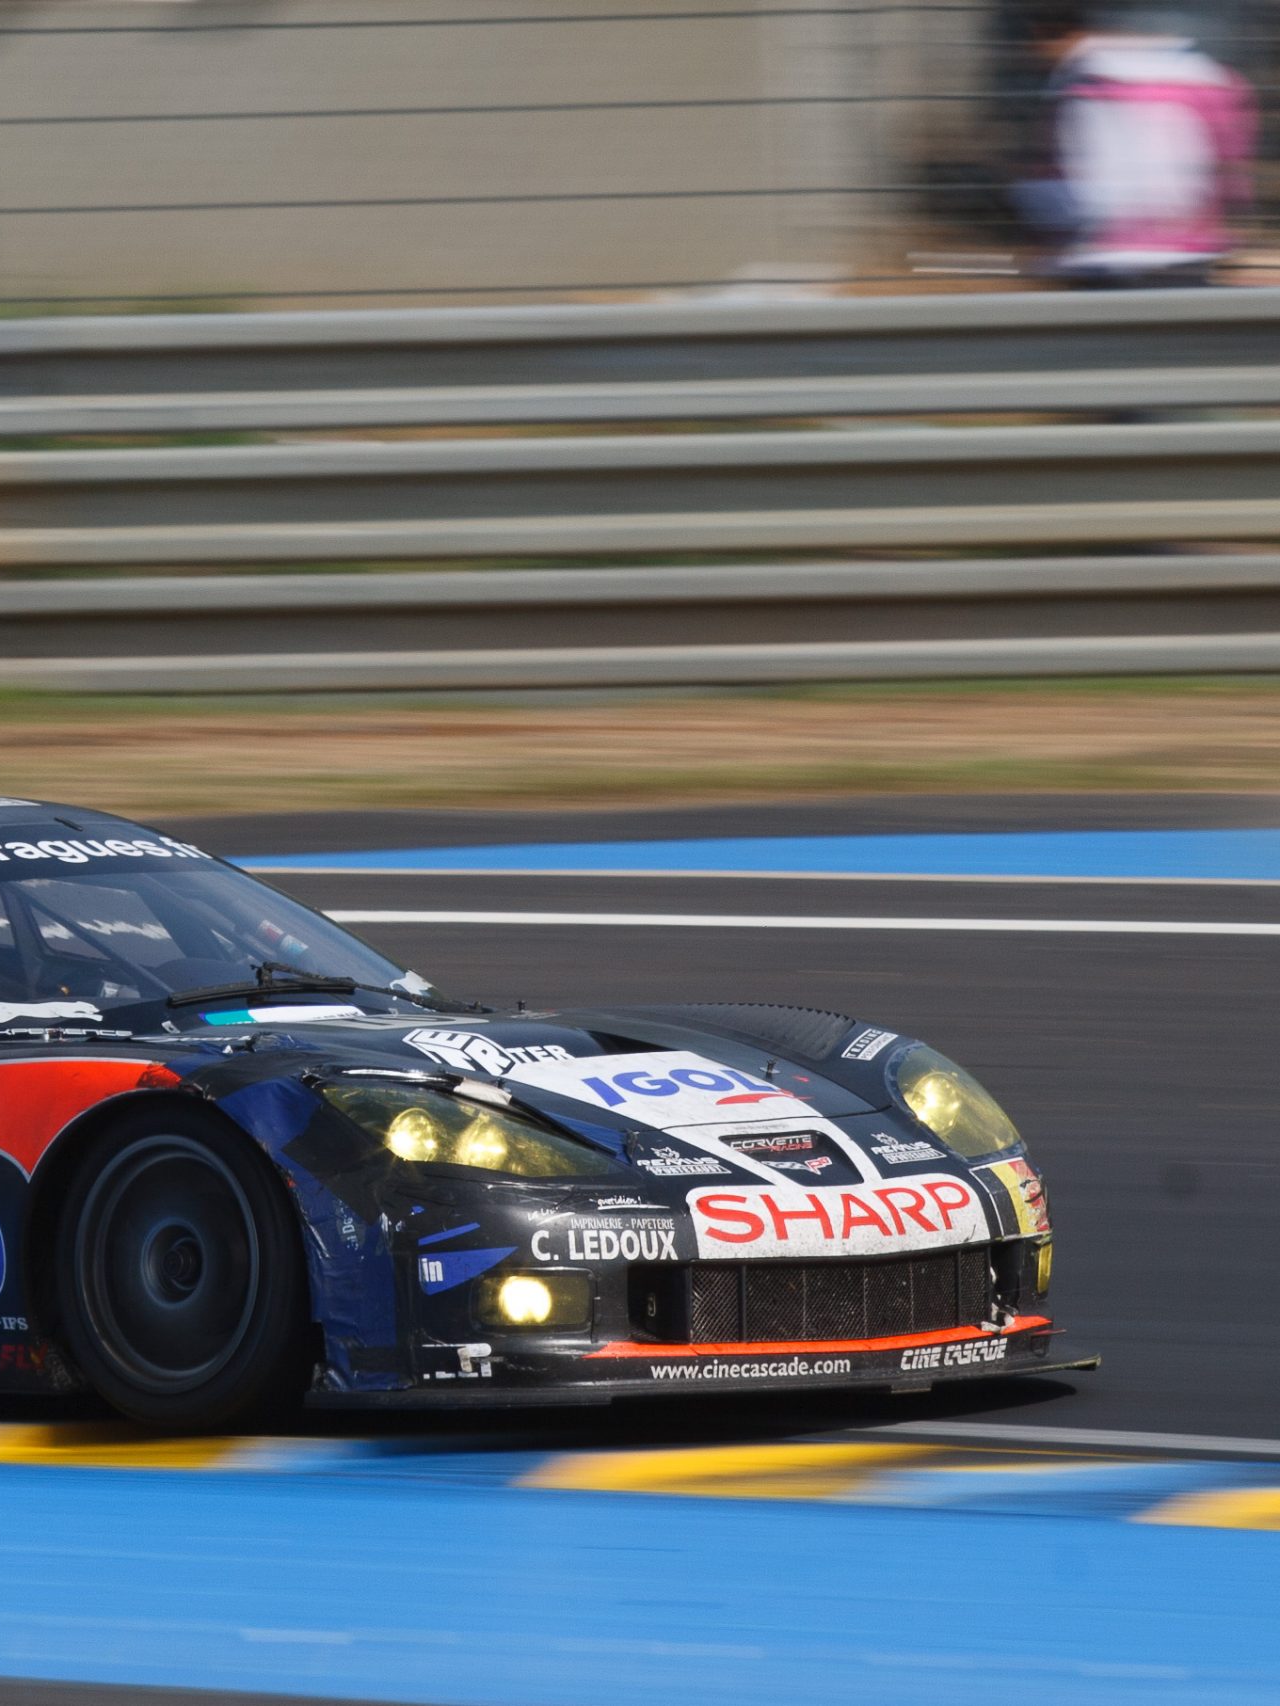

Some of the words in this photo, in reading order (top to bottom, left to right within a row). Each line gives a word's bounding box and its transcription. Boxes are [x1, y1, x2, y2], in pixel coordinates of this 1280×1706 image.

[580, 1068, 781, 1107] IGOL
[730, 1134, 812, 1150] CORVETTE
[570, 1217, 623, 1230] IMPRIMERIE
[630, 1218, 675, 1230] PAPETERIE
[695, 1183, 972, 1244] SHARP
[531, 1229, 559, 1261] C.
[568, 1229, 679, 1261] LEDOUX
[650, 1356, 851, 1380] www.cinecascade.com
